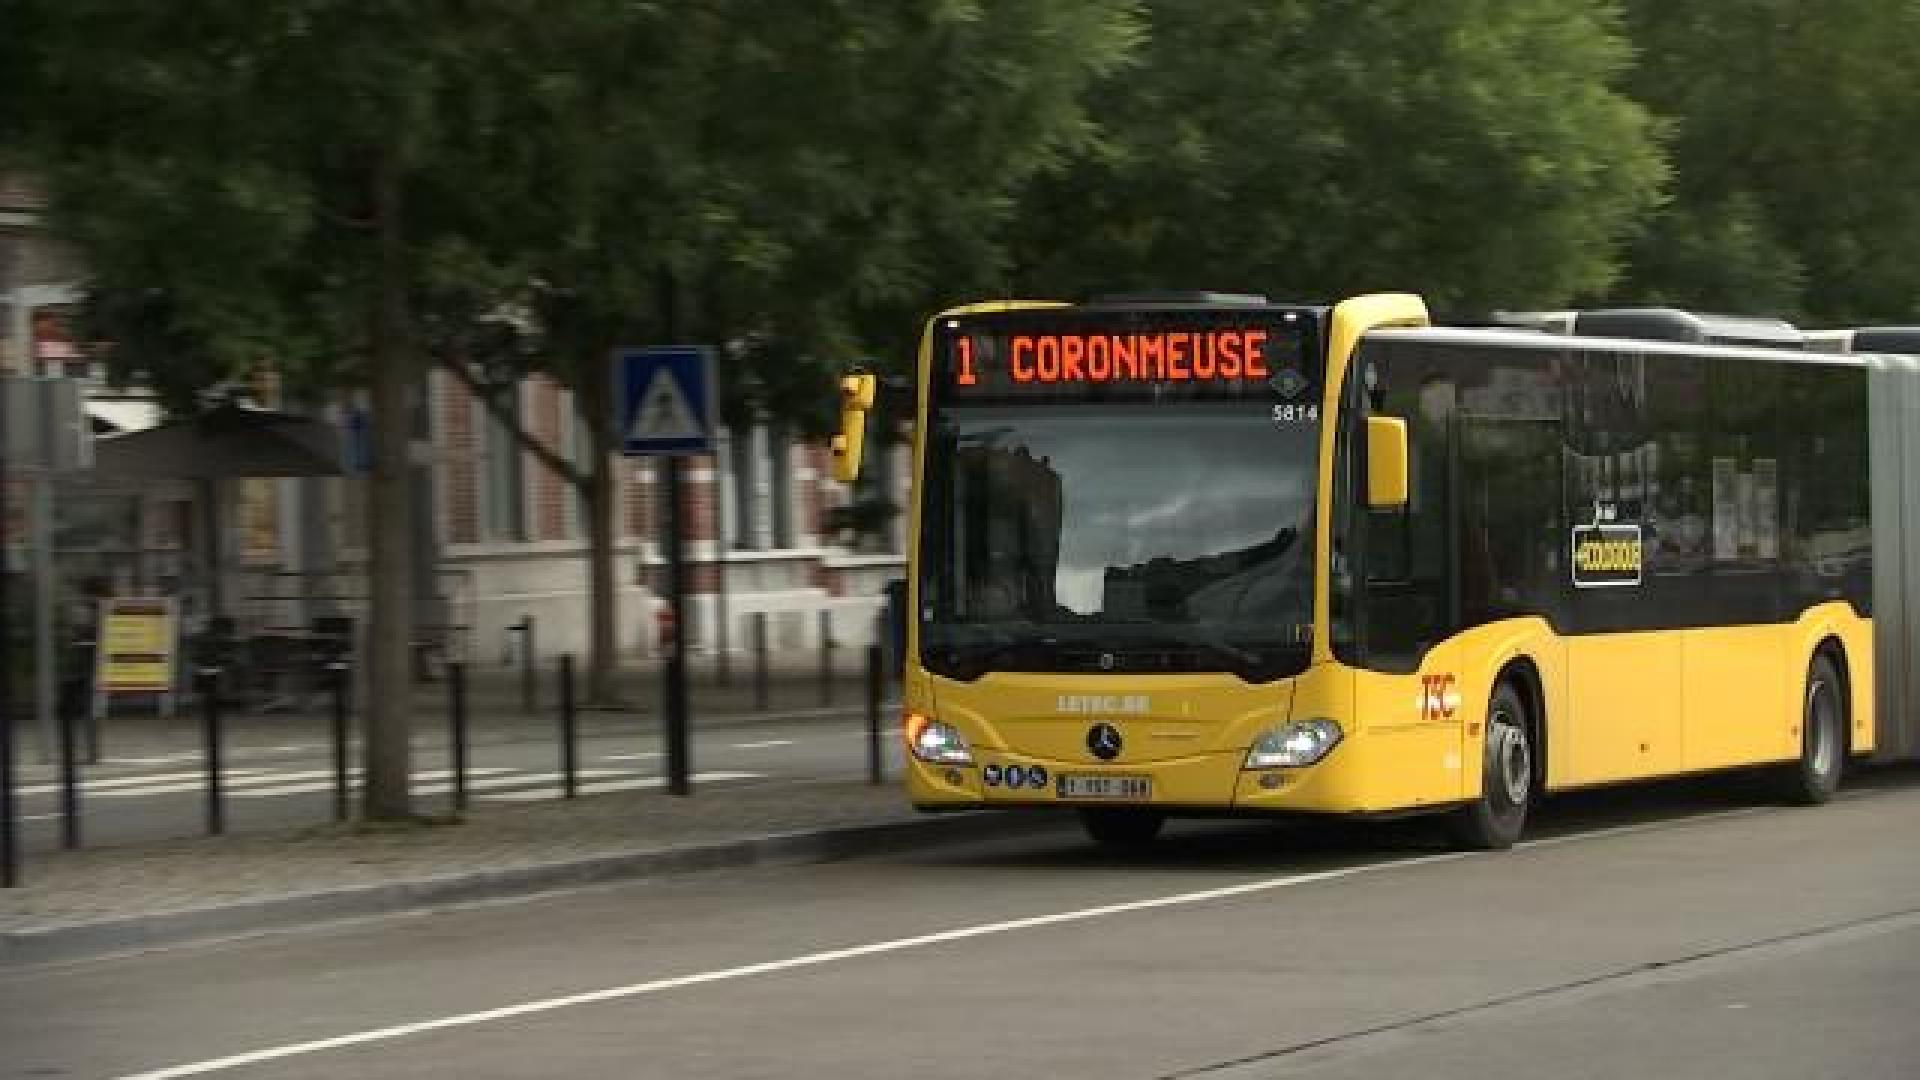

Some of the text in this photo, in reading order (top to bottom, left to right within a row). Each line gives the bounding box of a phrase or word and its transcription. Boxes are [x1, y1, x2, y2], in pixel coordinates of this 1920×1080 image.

[957, 331, 1268, 385] 1 CORONMEUSE
[1271, 404, 1319, 422] 5814
